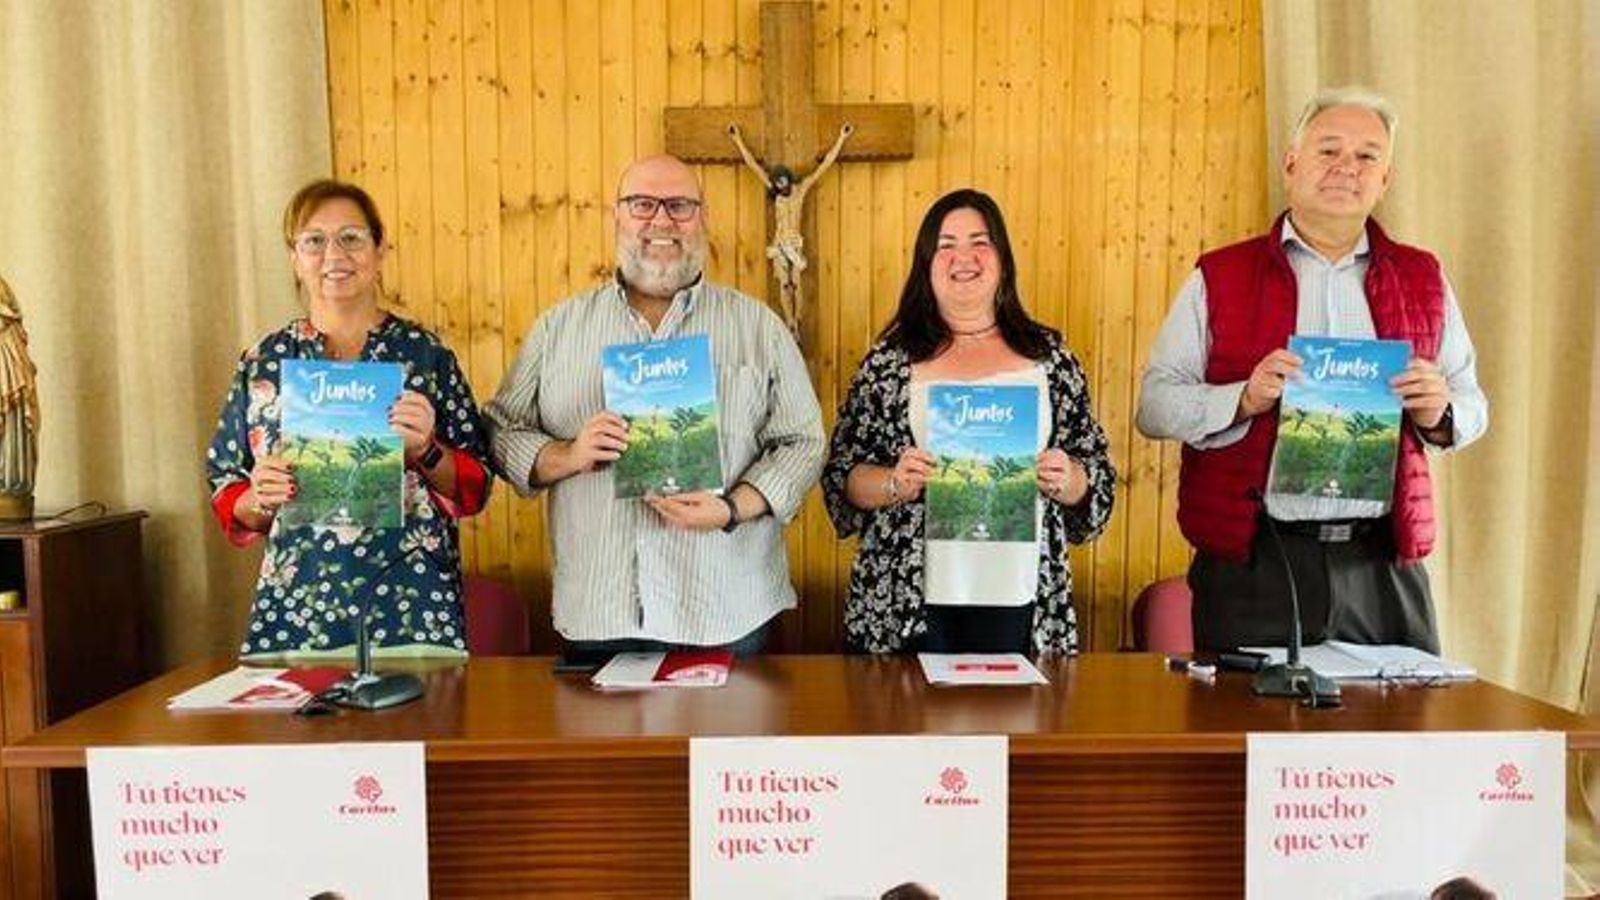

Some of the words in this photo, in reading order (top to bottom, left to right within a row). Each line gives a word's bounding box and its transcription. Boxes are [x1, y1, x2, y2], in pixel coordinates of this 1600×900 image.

[630, 352, 689, 384] Juntos
[1313, 347, 1380, 381] Juntos
[308, 371, 377, 404] Juntos
[955, 394, 1015, 426] Juntos
[760, 771, 839, 793] tienes
[1316, 767, 1395, 789] tienes
[163, 781, 247, 804] tienes
[718, 800, 811, 823] mucho
[1274, 795, 1367, 819] mucho
[121, 810, 219, 836] mucho
[718, 836, 768, 859] que
[774, 836, 814, 854] ver
[1274, 832, 1322, 855] que
[1329, 832, 1370, 850] ver
[123, 847, 175, 872] que
[182, 847, 224, 866] ver
